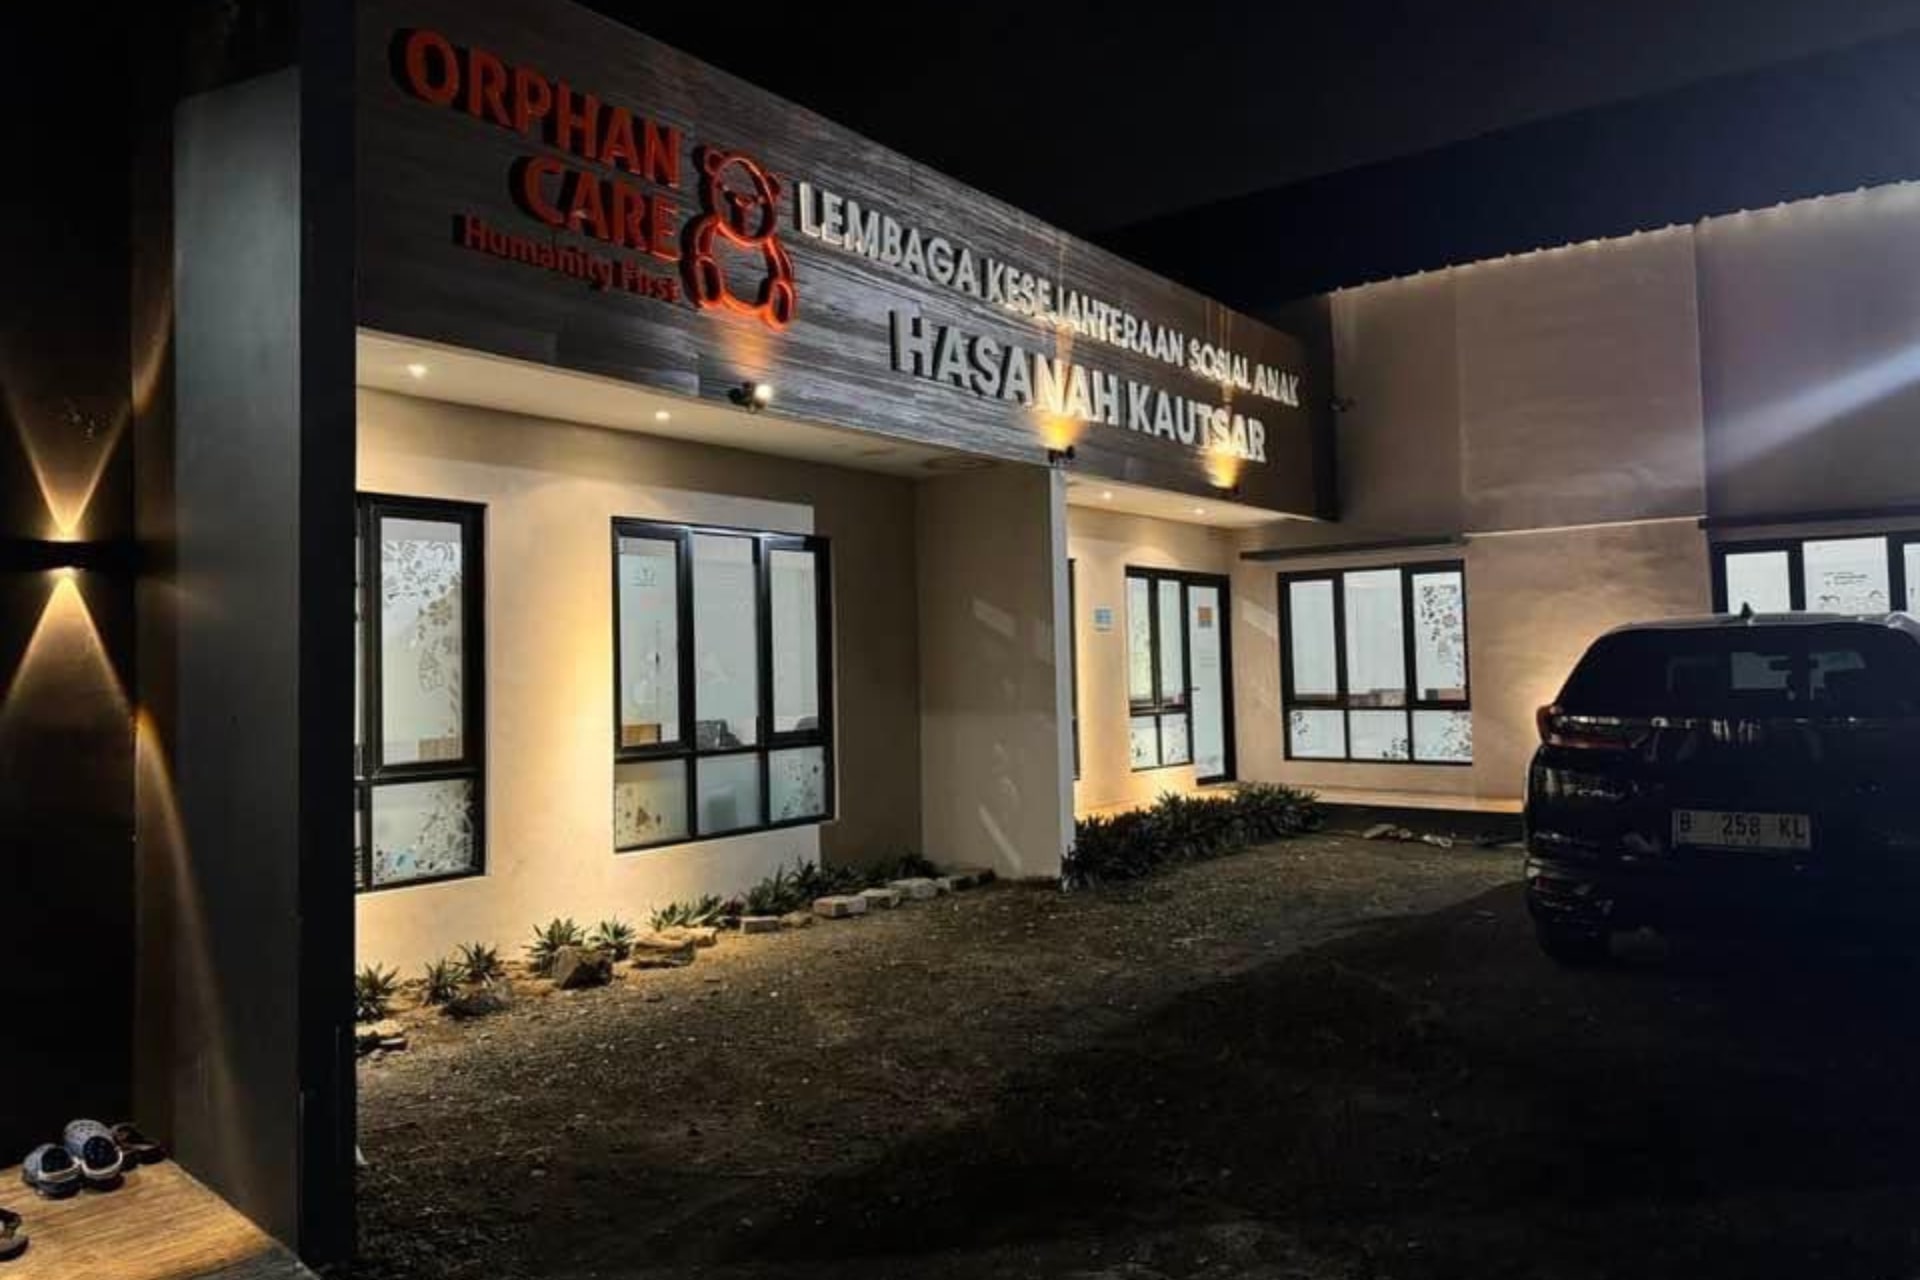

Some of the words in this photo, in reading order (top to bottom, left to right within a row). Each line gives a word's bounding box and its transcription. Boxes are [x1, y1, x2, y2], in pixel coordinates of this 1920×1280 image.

[404, 29, 684, 189] ORPHAN
[464, 214, 614, 292] Humanity
[620, 257, 682, 303] First
[523, 156, 681, 263] CARE
[799, 181, 979, 297] LEMBAGA
[987, 258, 1184, 366] KESEJAHTERAAN
[1188, 337, 1251, 391] SOSIAL
[1253, 362, 1299, 406] ANAK
[899, 302, 1119, 425] HASANAH
[1128, 370, 1266, 463] KAUTSAR
